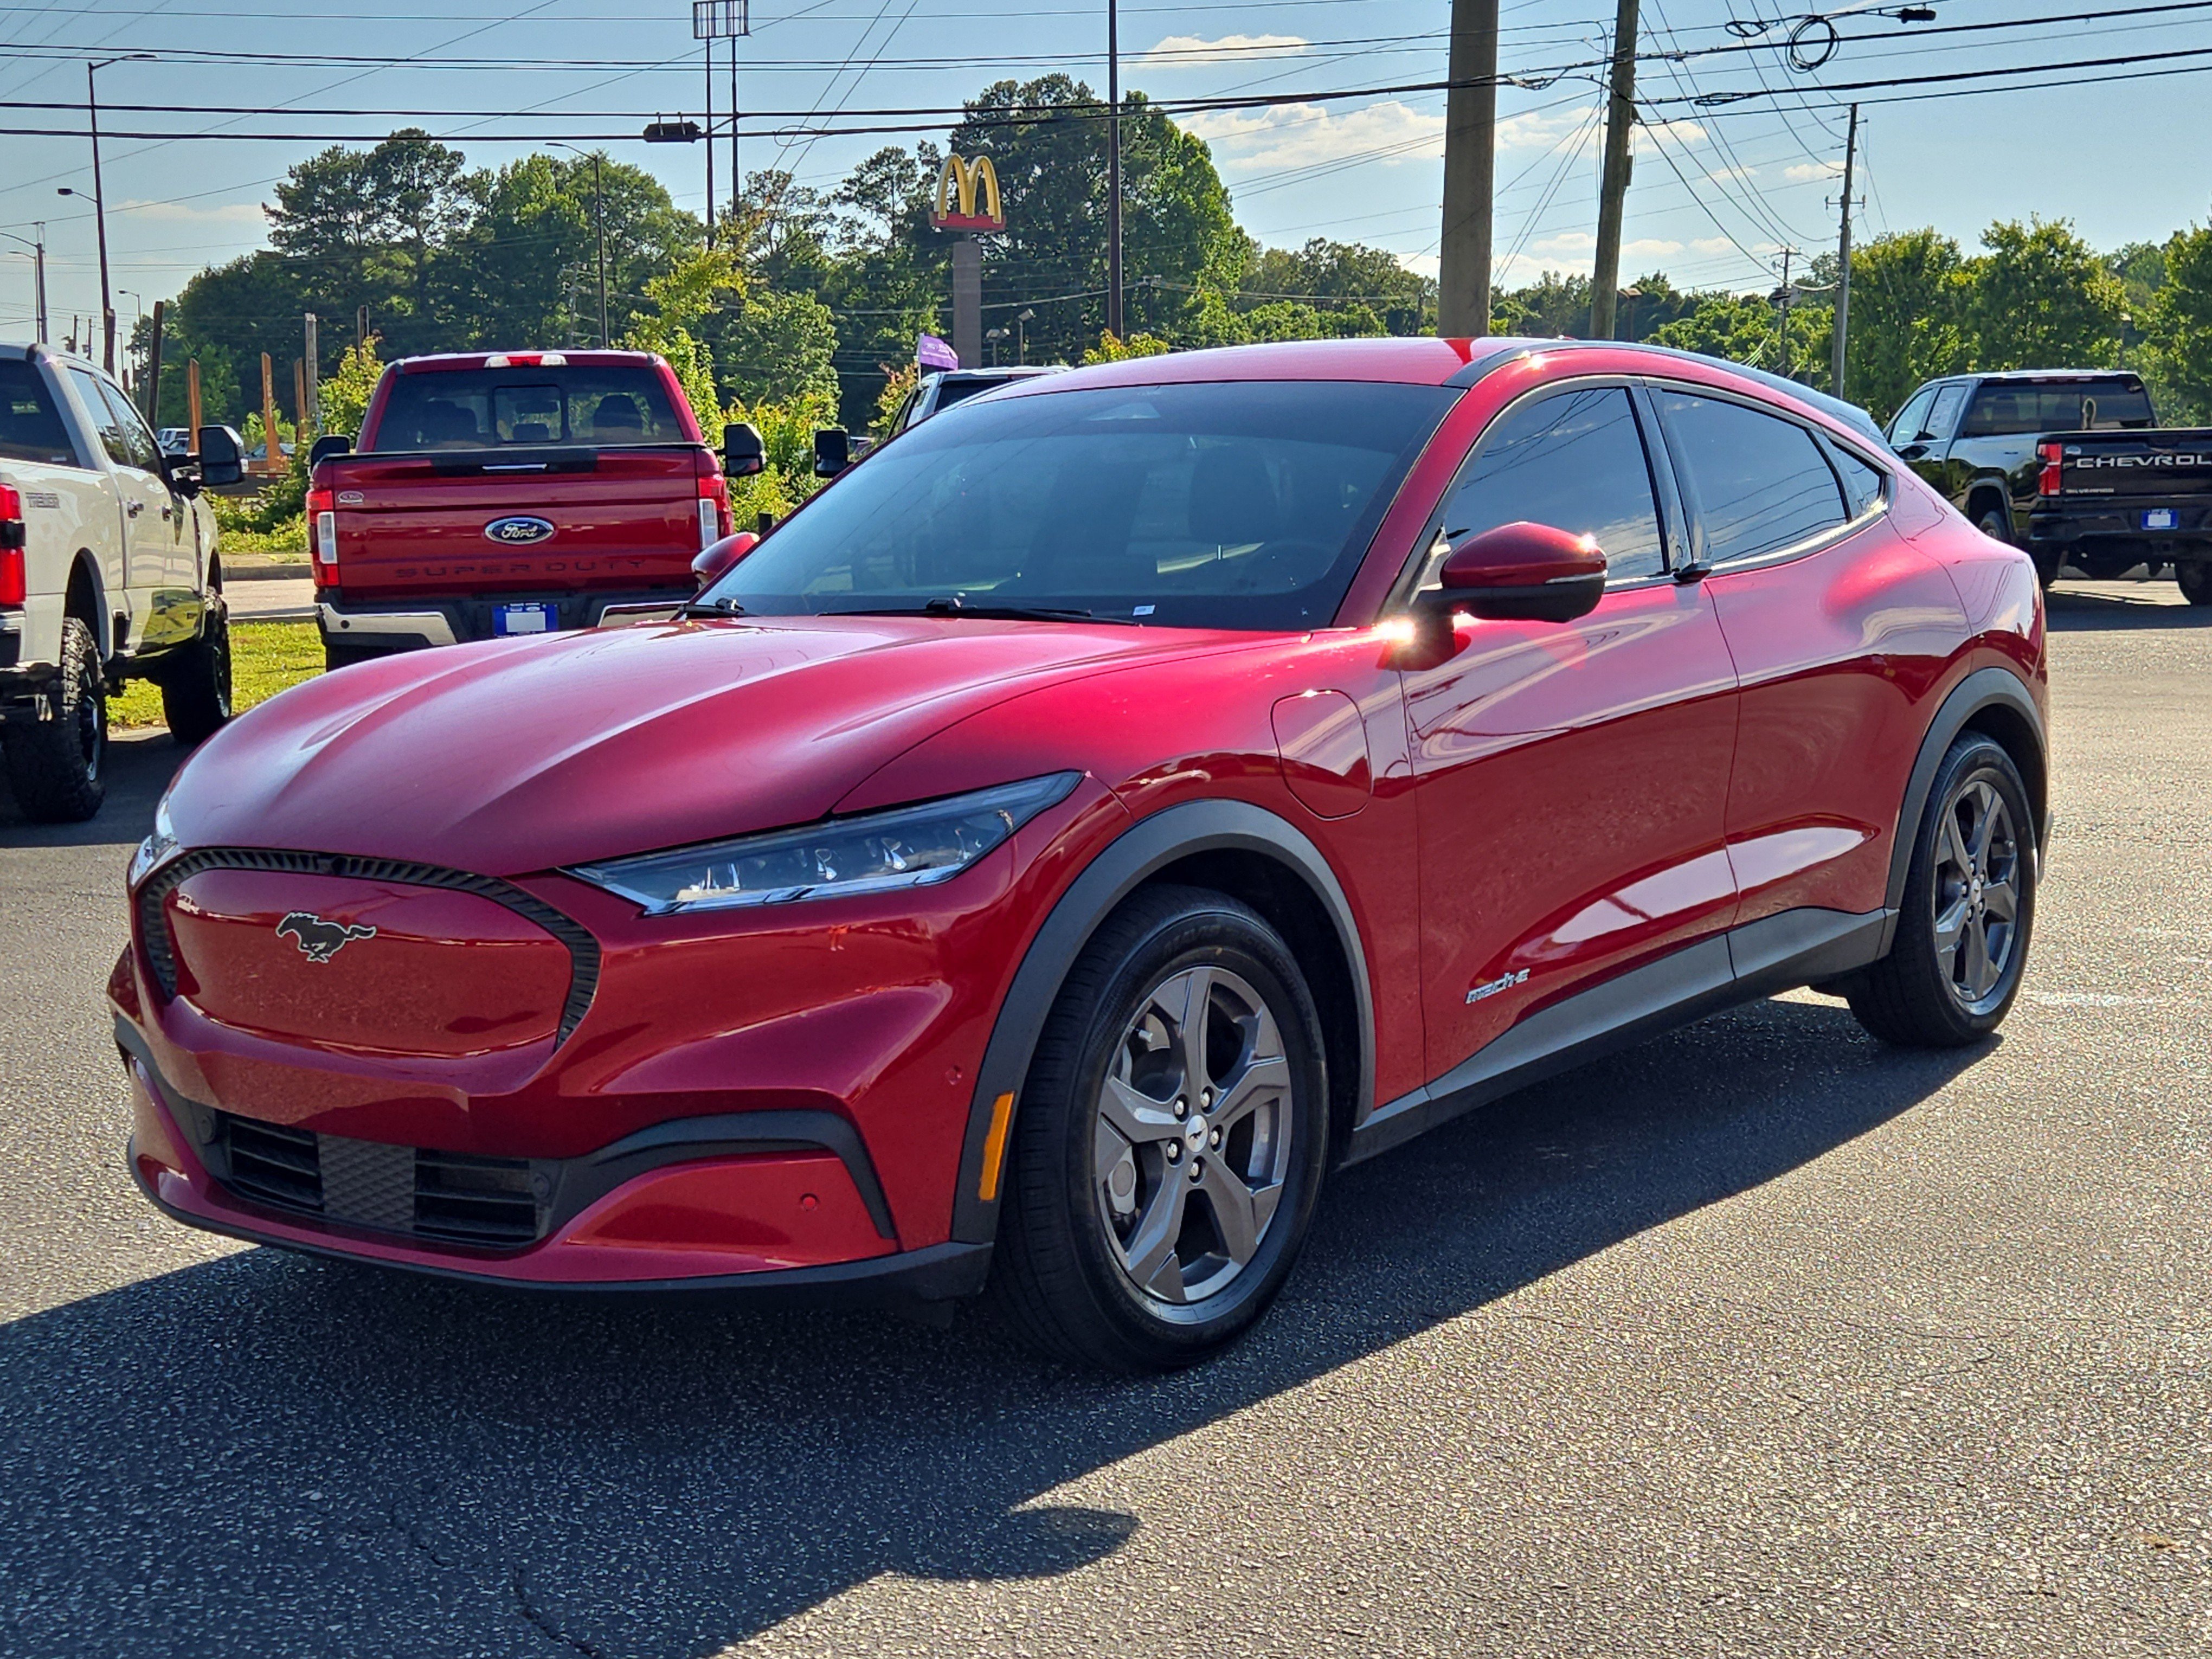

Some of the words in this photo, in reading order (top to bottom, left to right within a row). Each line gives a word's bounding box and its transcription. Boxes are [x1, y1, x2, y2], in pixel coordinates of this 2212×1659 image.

[501, 523, 538, 538] Ford
[395, 563, 530, 578] SUPER
[544, 559, 646, 571] DUTY
